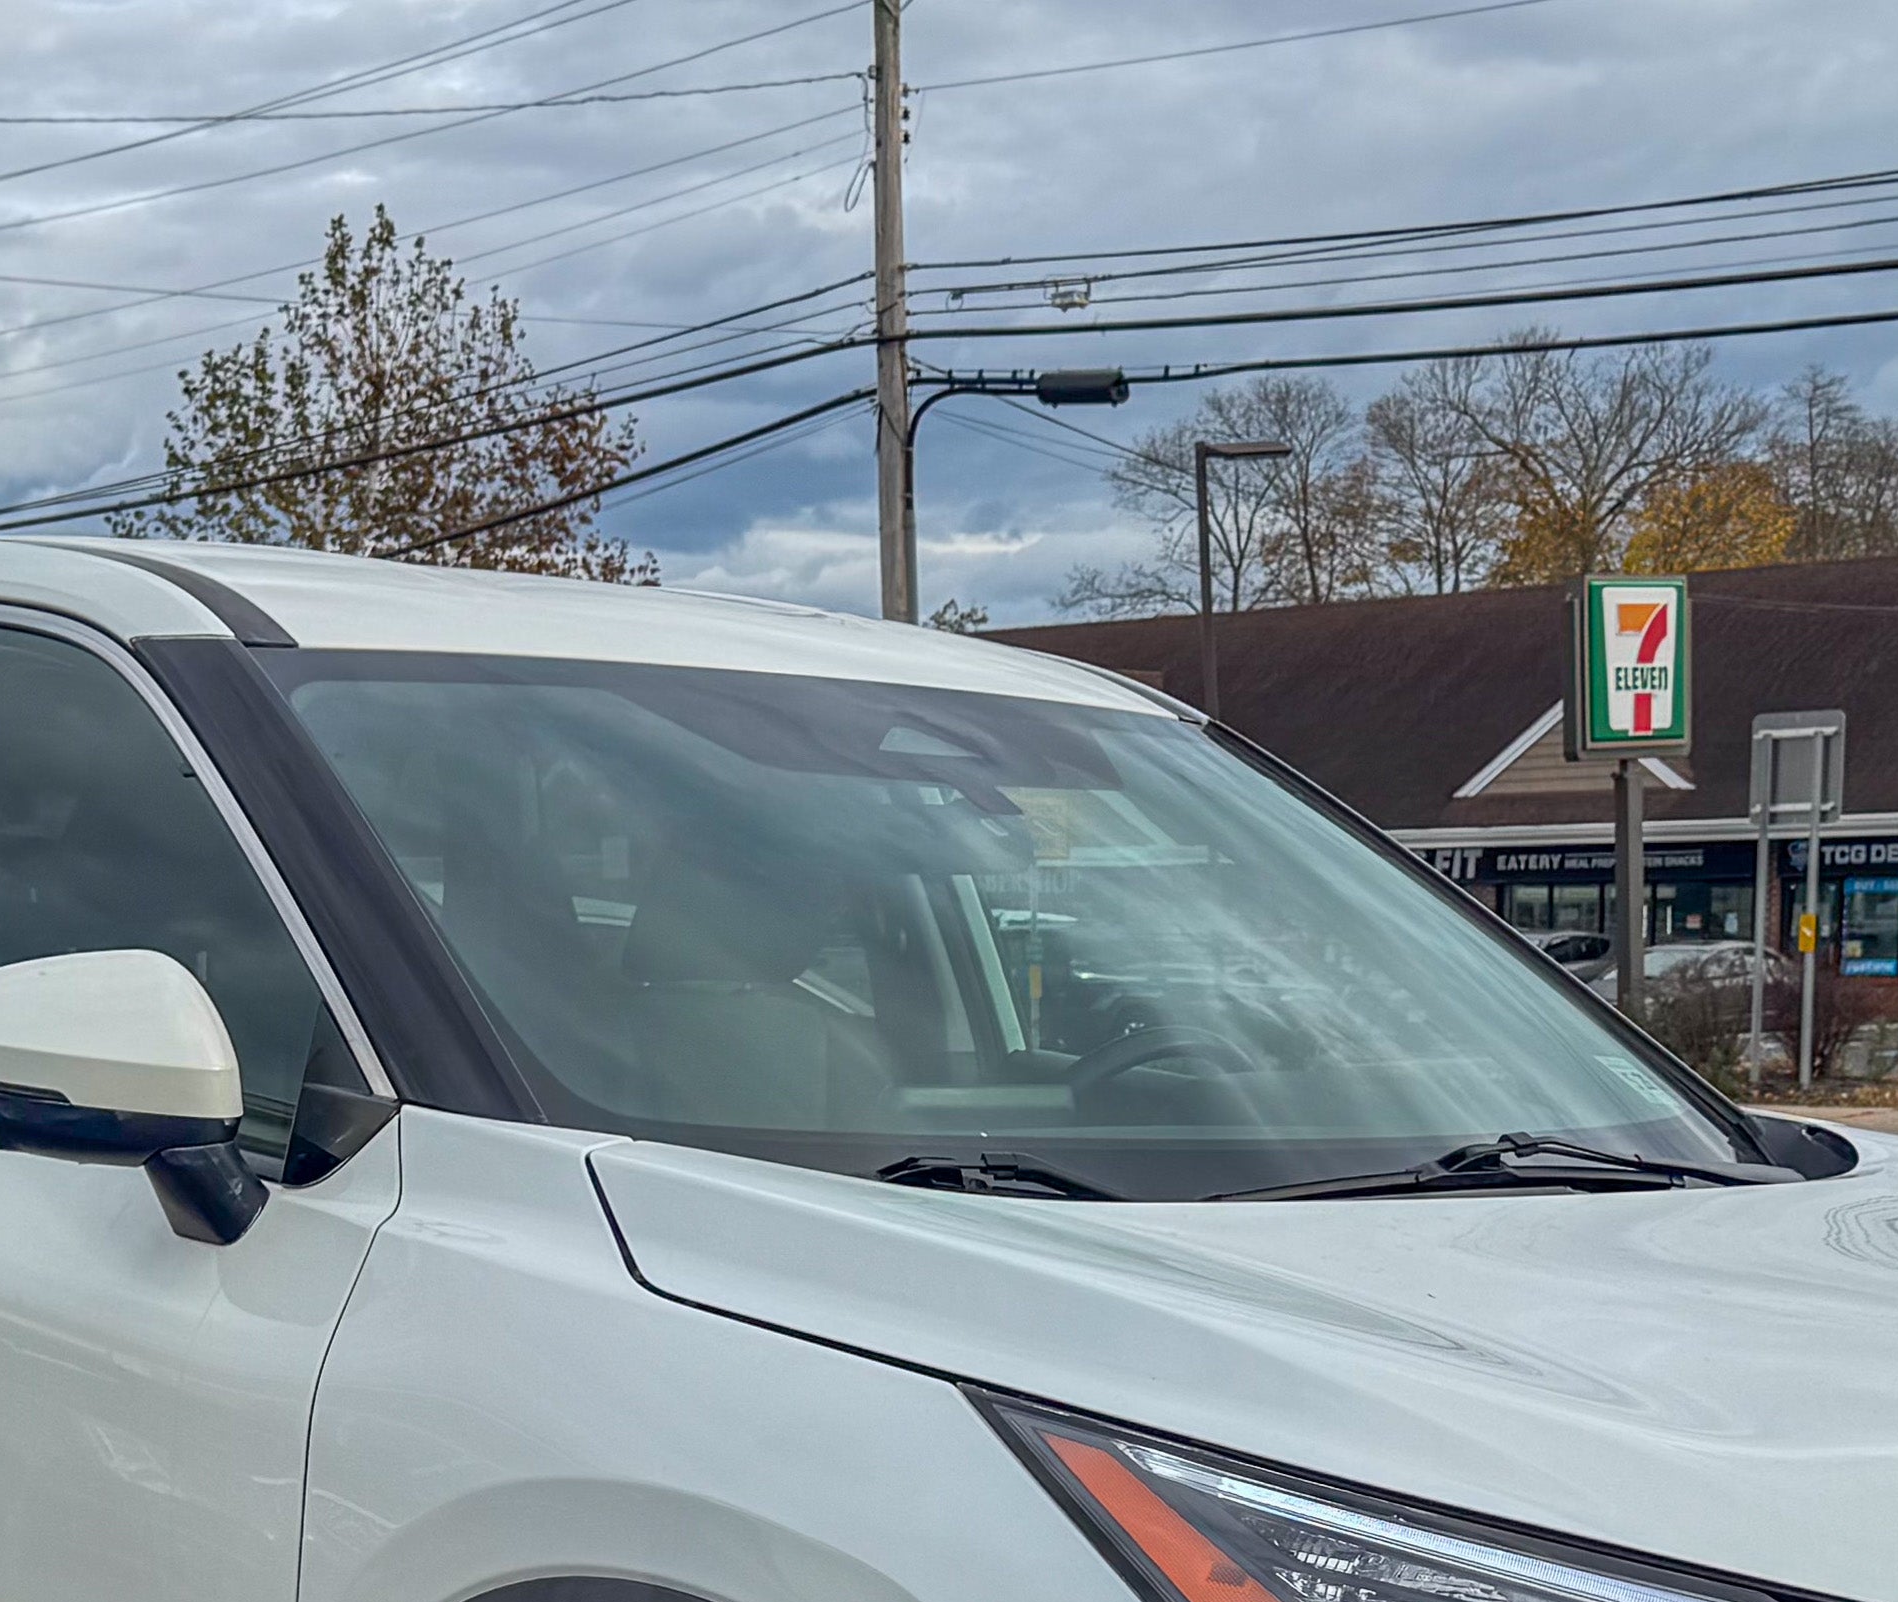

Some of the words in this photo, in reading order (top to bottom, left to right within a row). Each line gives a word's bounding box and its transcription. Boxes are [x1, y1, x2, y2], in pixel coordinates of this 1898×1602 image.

[1618, 603, 1668, 732] 7
[1497, 853, 1563, 872] EATERY
[1821, 844, 1867, 865] TCG
